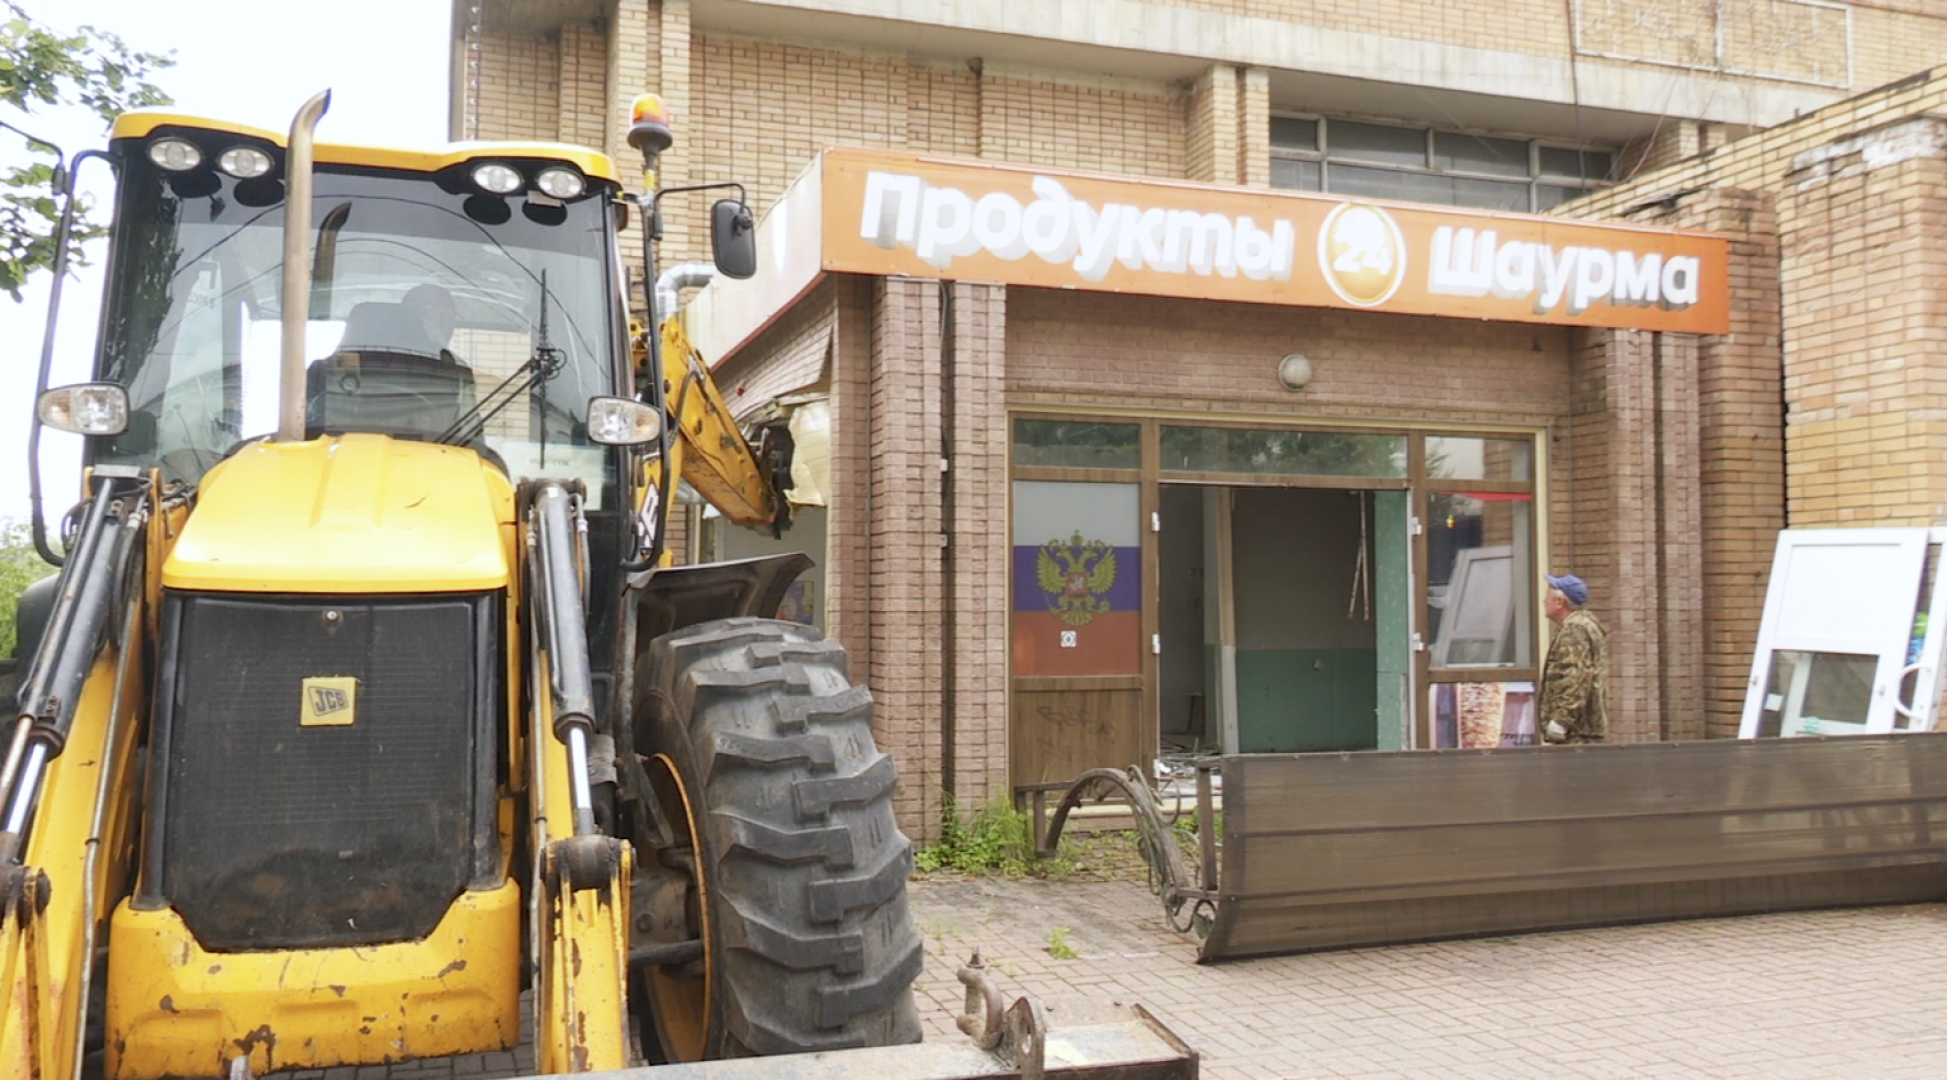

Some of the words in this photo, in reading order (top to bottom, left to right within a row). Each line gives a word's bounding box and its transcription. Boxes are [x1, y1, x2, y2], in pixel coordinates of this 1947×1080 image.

[861, 172, 1292, 277] Продукты
[1333, 224, 1391, 276] 24
[1429, 226, 1700, 310] Шаурма
[315, 689, 346, 712] JCB
